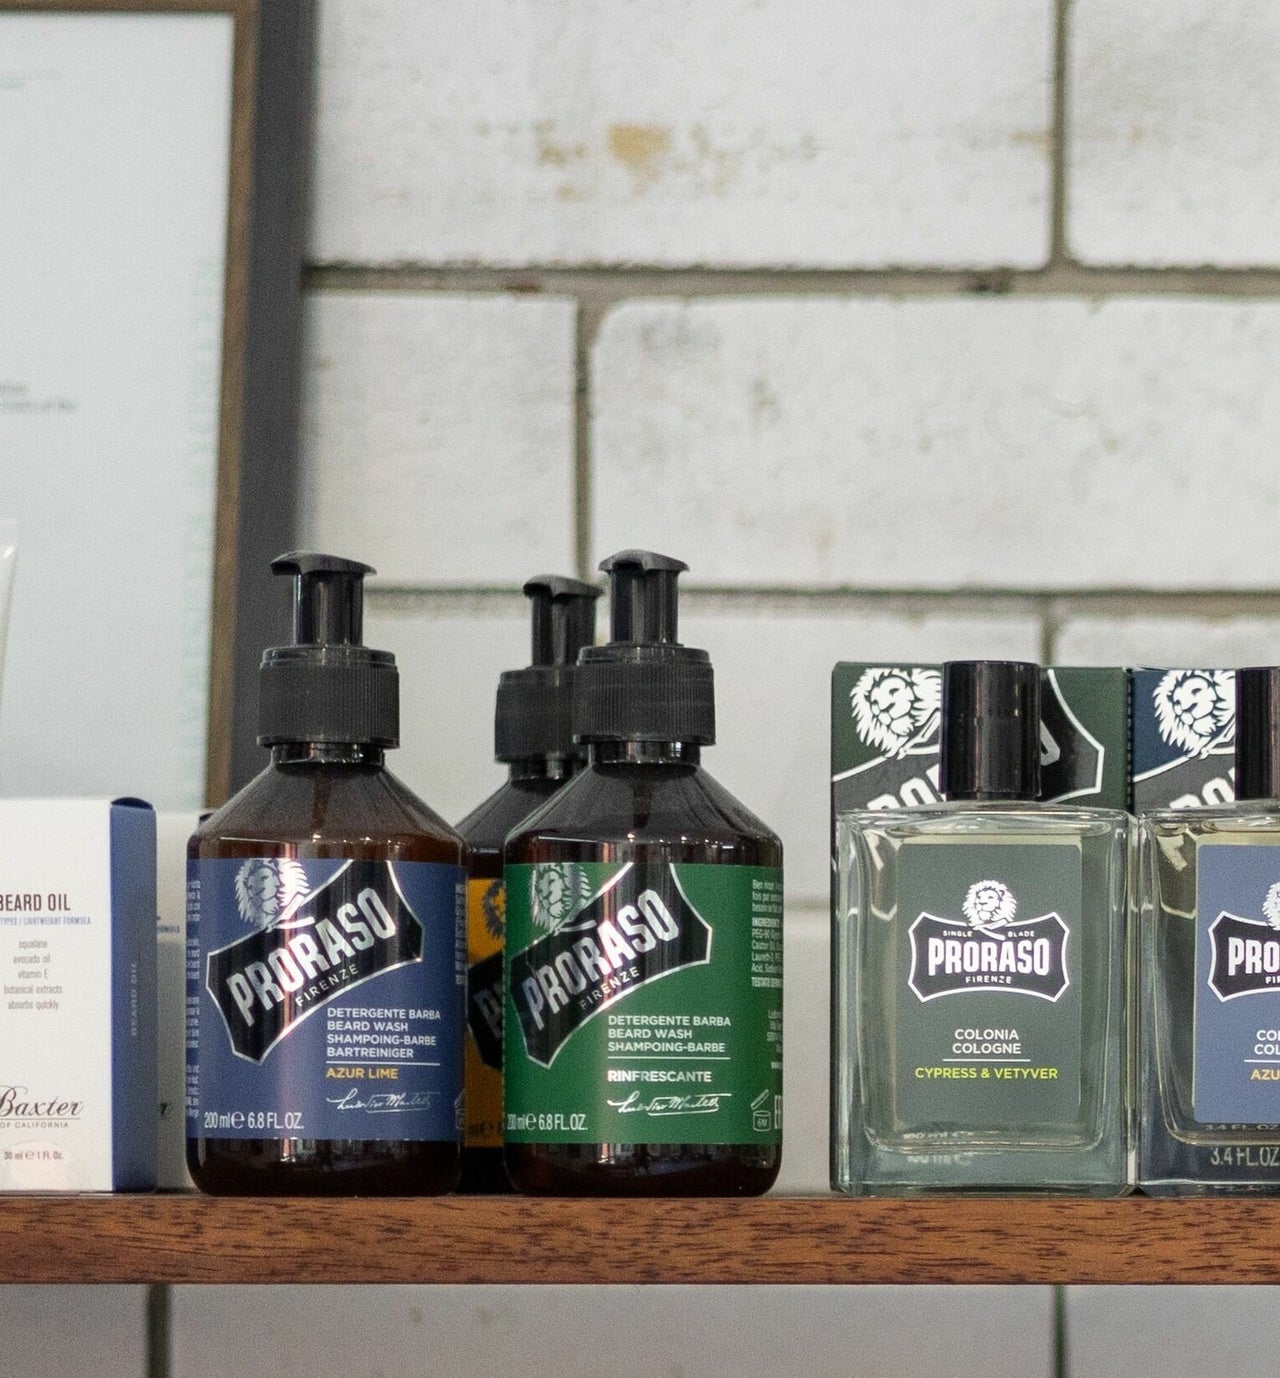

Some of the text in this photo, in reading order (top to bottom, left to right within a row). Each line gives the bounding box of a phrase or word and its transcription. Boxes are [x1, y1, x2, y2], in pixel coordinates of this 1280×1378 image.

[13, 955, 50, 964] avocado oil
[227, 887, 396, 1026] PRORASO
[522, 889, 679, 1031] PRORASO
[928, 938, 1051, 976] PRORASO
[18, 970, 39, 979] vitamin
[966, 975, 1012, 984] FIRENZE
[295, 964, 359, 1007] FIRENZE
[327, 1008, 441, 1020] DETERGENTE BARBA
[327, 1021, 408, 1032] BEARD WASH
[608, 1028, 692, 1039] BEARD WASH
[955, 1028, 1019, 1040] COLONIA
[327, 1034, 436, 1046] SHAMPOING-BARBE
[608, 1041, 725, 1053] SHAMPOING-BARBE
[952, 1042, 1021, 1054] COLOGNE
[327, 1048, 413, 1059] BARTREINIGER
[326, 1068, 398, 1079] AZUR LIME
[608, 1071, 712, 1082] RINFRESCANTE
[915, 1067, 1058, 1079] CYPRESS & VETYVER
